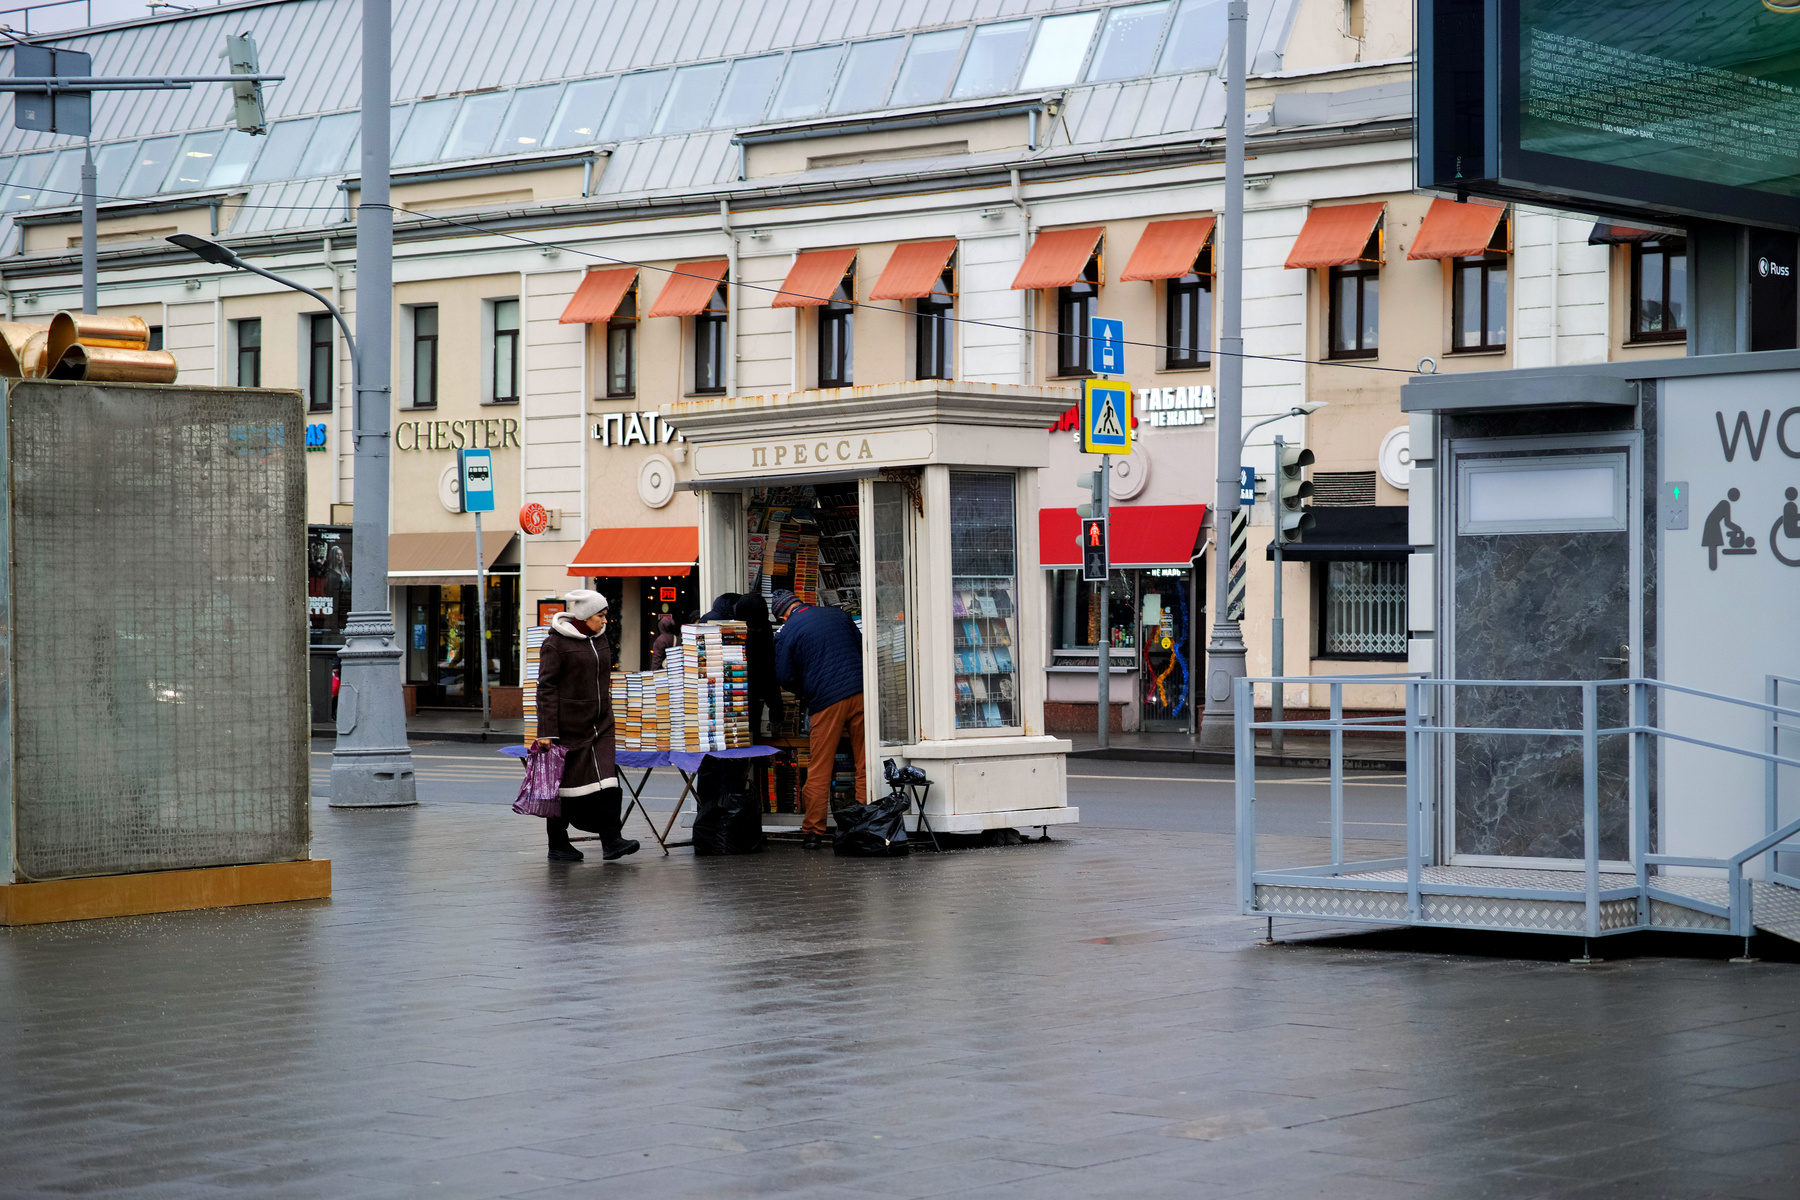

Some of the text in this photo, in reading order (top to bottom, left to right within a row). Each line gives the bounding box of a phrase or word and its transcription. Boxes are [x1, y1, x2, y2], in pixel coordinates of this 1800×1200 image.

[1770, 262, 1790, 276] Russ
[1138, 385, 1215, 411] ТАБАКА
[396, 418, 521, 450] CHESTER
[752, 439, 873, 467] ПРЕССА
